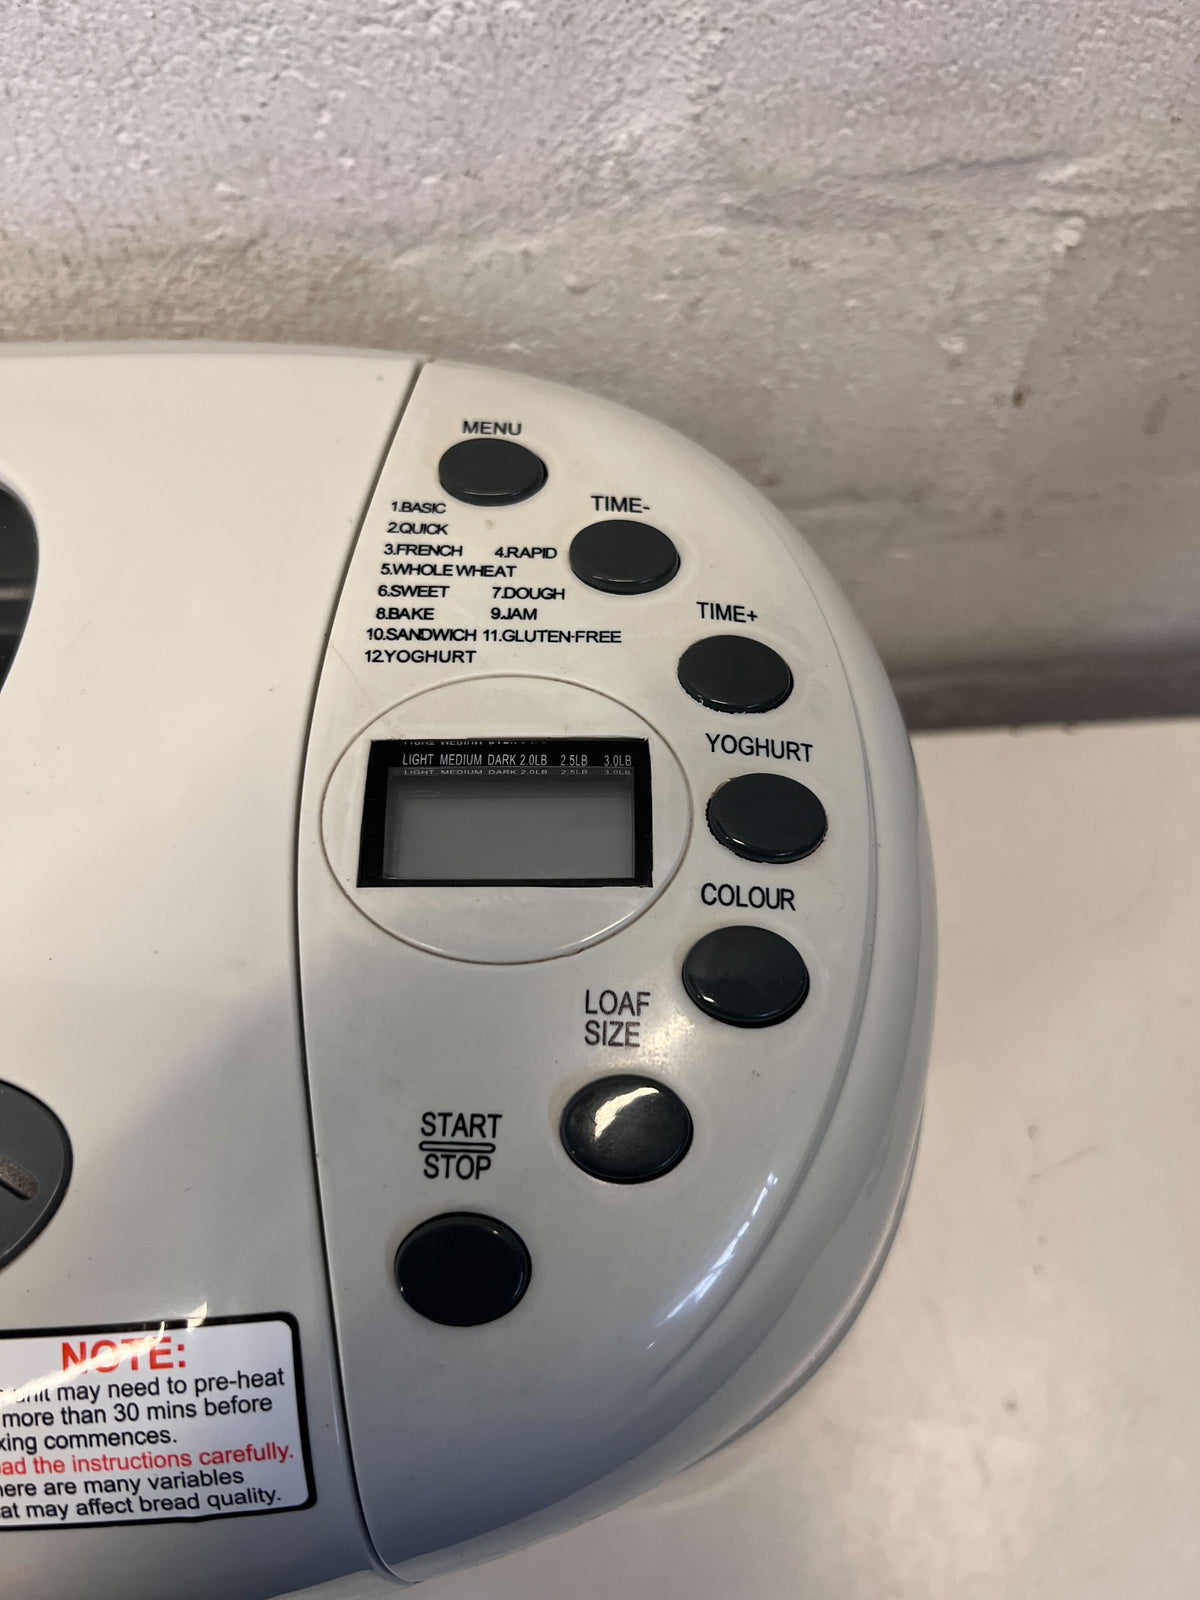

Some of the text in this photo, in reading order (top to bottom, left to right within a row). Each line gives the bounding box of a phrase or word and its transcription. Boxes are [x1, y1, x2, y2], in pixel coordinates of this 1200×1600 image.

[462, 420, 522, 436] MENU
[390, 501, 447, 515] 1.BASIC
[591, 495, 650, 513] TIME-
[386, 522, 449, 536] 2.QUICK
[383, 543, 463, 557] 3.FRENCH
[494, 547, 558, 559] 4.RAPID
[380, 563, 517, 578] 5.WHOLE WHEAT
[377, 585, 450, 598] 6.SWEET
[492, 587, 566, 600] 7.DOUGH
[375, 607, 435, 620] 8.BAKE
[490, 607, 538, 620] 9.JAM
[697, 602, 758, 622] TIME+
[366, 628, 477, 642] 10.SANDWICH
[483, 630, 622, 643] 11.GLUTEN-FREE
[705, 733, 813, 763] YOGHURT
[402, 753, 632, 766] LIGHT MEDIUM DARK 2.0LB 2.5LB 3.0LB
[701, 883, 796, 911] COLOUR
[585, 989, 651, 1016] LOAF
[584, 1020, 641, 1047] SIZE
[421, 1112, 503, 1138] START
[423, 1154, 492, 1180] STOP
[61, 1336, 186, 1374] NOTE:
[57, 1384, 100, 1404] may
[108, 1377, 160, 1398] need
[167, 1376, 187, 1395] to
[195, 1367, 285, 1397] pre-heat
[2, 1396, 273, 1428] more than 30 mins before
[44, 1428, 177, 1452] commences.
[0, 1441, 294, 1475] ad the instructions carefully.
[0, 1468, 244, 1497] ere are many variables
[26, 1503, 69, 1521] may
[76, 1492, 134, 1516] affect
[139, 1491, 200, 1513] bread
[207, 1487, 281, 1509] quality.
